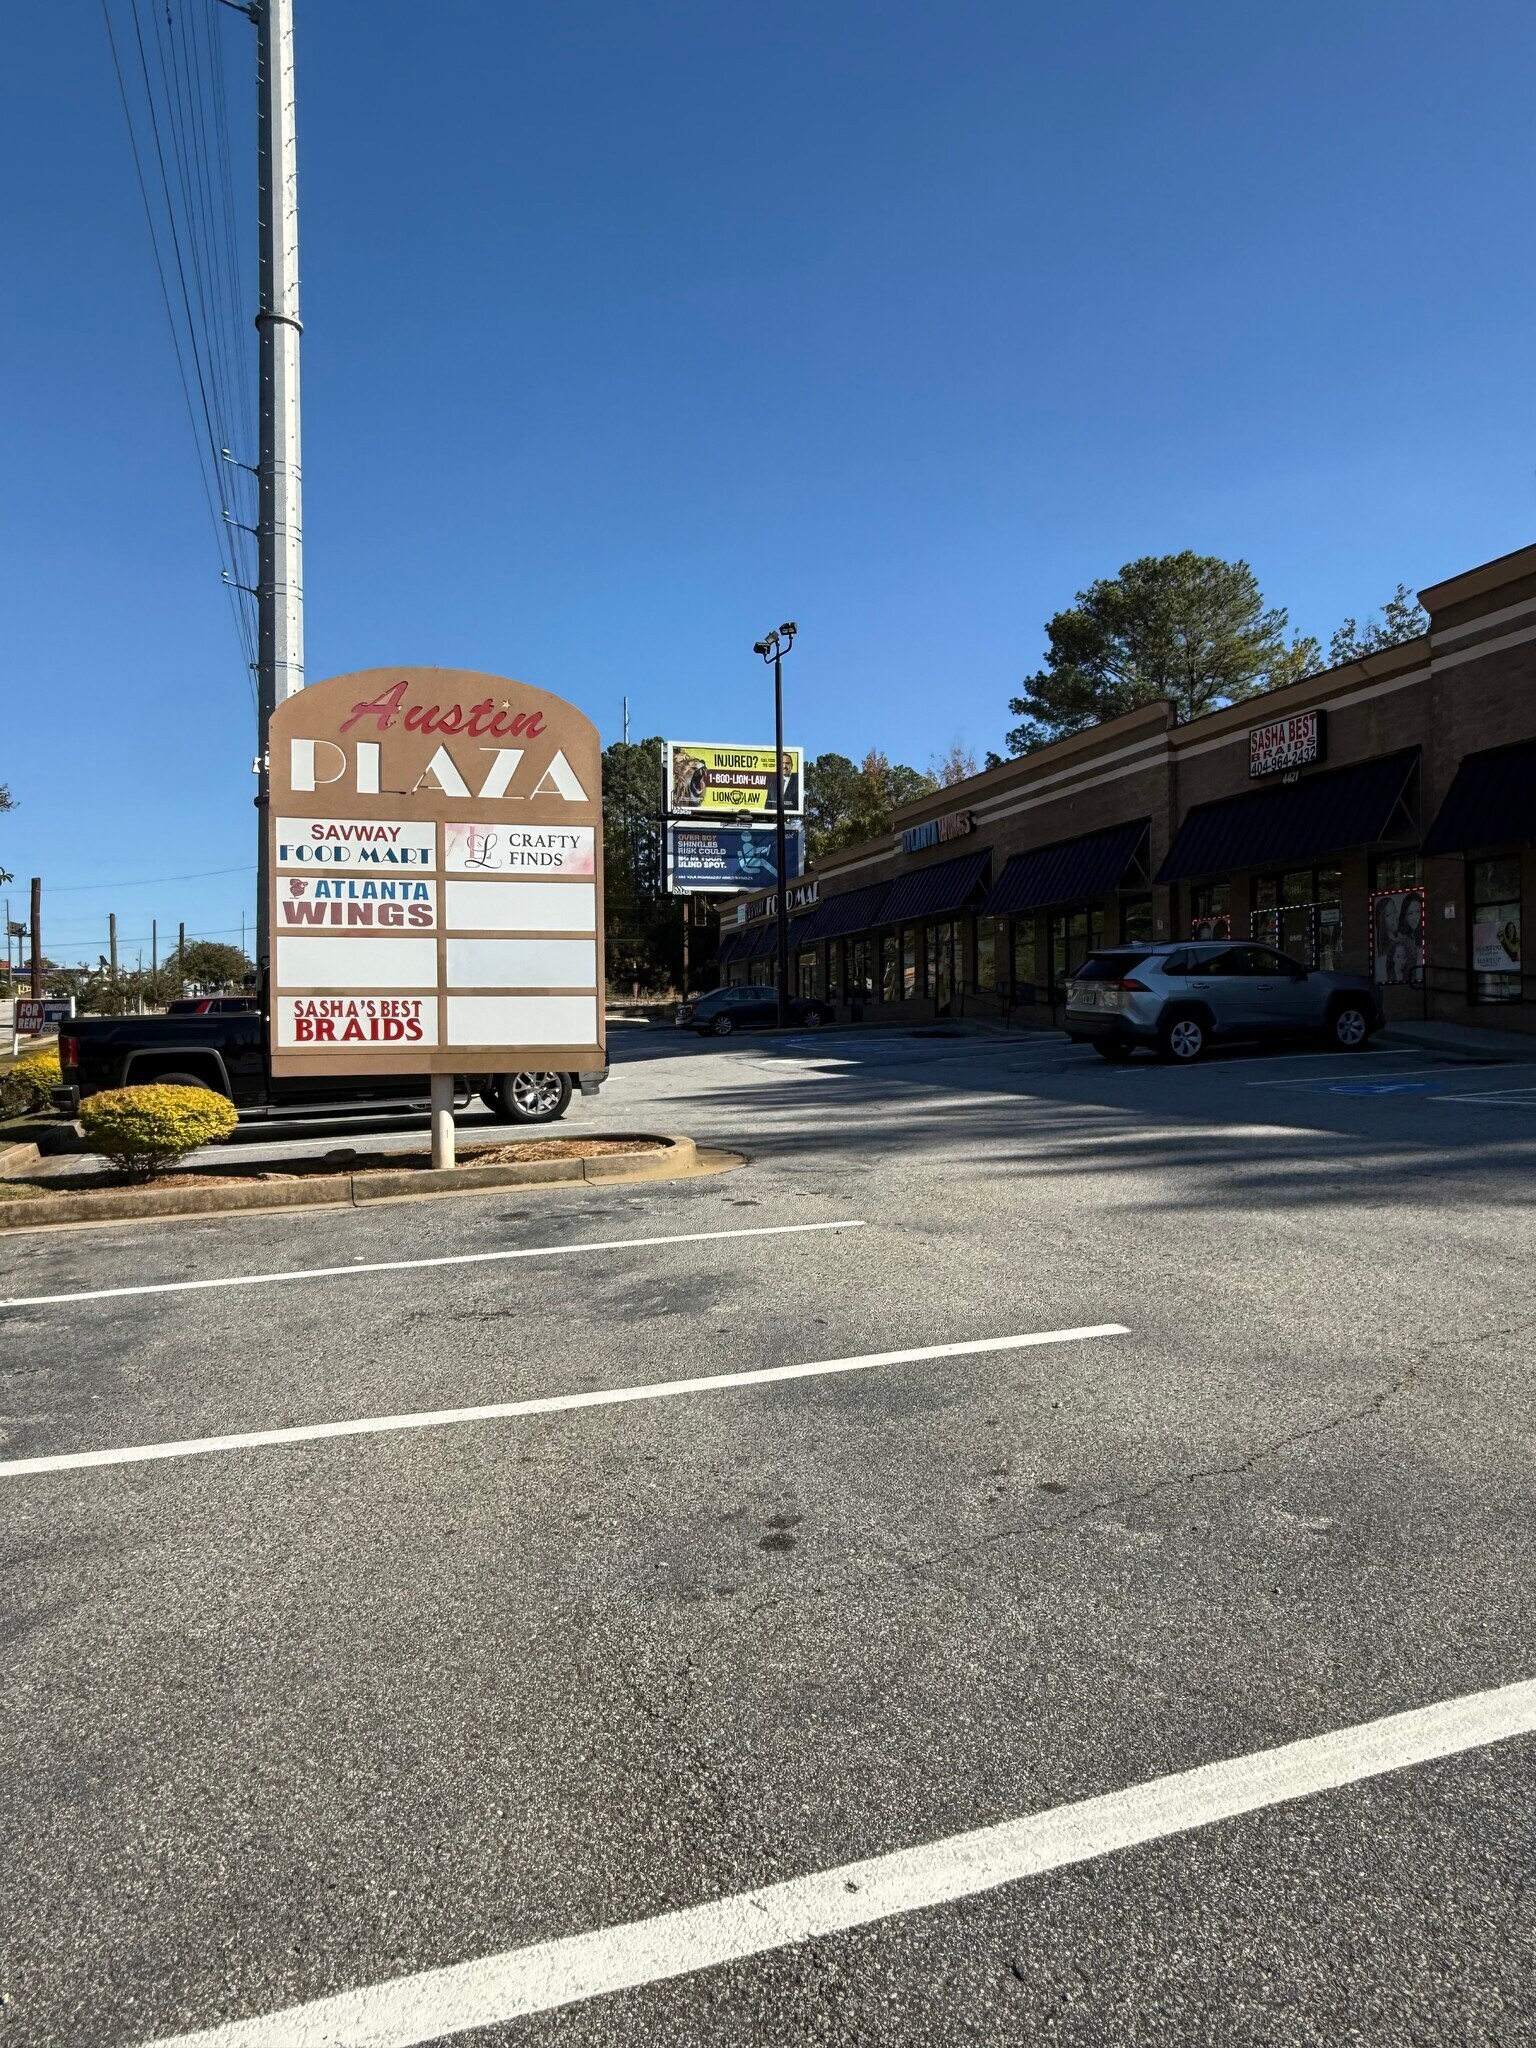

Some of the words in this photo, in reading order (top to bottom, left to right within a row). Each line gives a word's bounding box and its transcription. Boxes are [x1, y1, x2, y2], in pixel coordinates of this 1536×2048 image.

[339, 680, 547, 739] Austin
[1252, 724, 1285, 753] SASHA
[1289, 714, 1316, 742] BEST
[1252, 737, 1316, 762] BRAIDS
[714, 754, 759, 769] INJURED?
[1252, 746, 1316, 774] 404-964-2432
[290, 738, 590, 801] PLAZA
[709, 773, 767, 785] 1-800-LION-LAW
[712, 791, 731, 802] LION
[743, 793, 760, 803] LAW
[311, 824, 402, 842] SAVWAY
[509, 833, 580, 848] CRAFTY
[280, 845, 350, 863] FOOD
[358, 847, 433, 864] MART
[509, 851, 563, 867] FINDS
[678, 847, 697, 855] RISK
[704, 861, 727, 869] SPOT.
[315, 880, 429, 900] ATLANTA
[766, 890, 793, 915] FOD
[283, 901, 433, 927] WINGS
[20, 1003, 39, 1016] FOR
[294, 1000, 376, 1018] SASHA'S
[380, 1000, 423, 1018] BEST
[17, 1018, 42, 1029] RENT
[294, 1018, 424, 1041] BRAIDS
